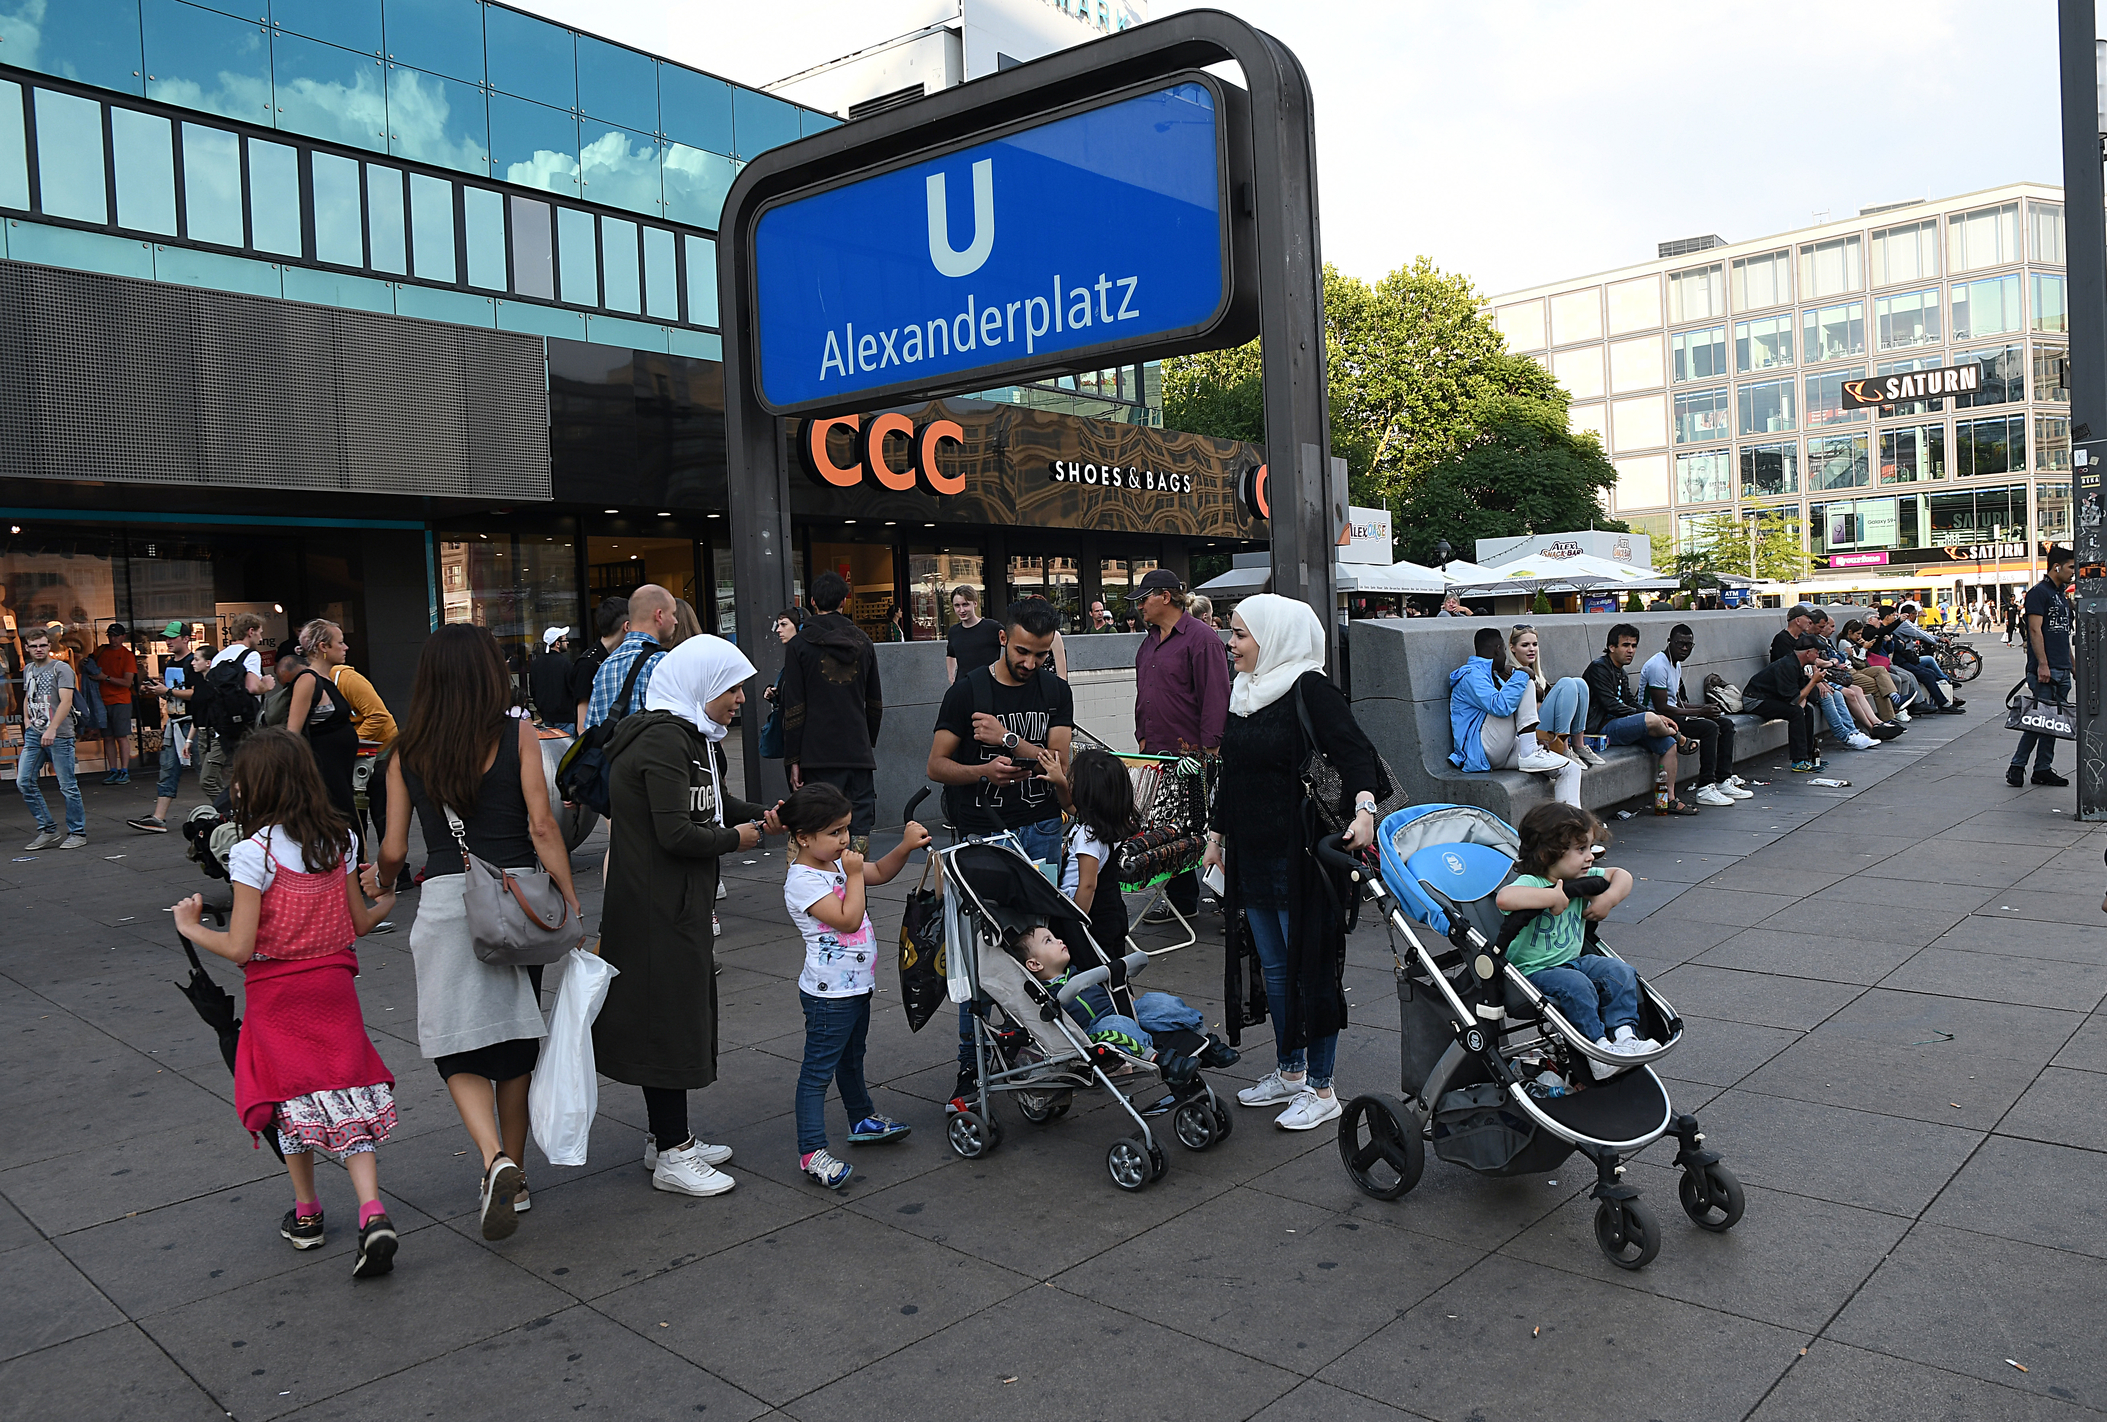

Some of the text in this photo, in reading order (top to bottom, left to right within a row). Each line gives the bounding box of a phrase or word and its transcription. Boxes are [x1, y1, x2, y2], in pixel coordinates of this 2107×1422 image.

[926, 158, 995, 278] U
[819, 273, 1140, 381] Alexanderplatz
[1886, 367, 1978, 400] SATURN
[810, 413, 966, 495] CCC
[1055, 460, 1192, 494] SHOES & BAGS
[1552, 541, 1578, 551] ALEX
[2021, 714, 2072, 733] adidas
[1530, 910, 1582, 951] RUN
